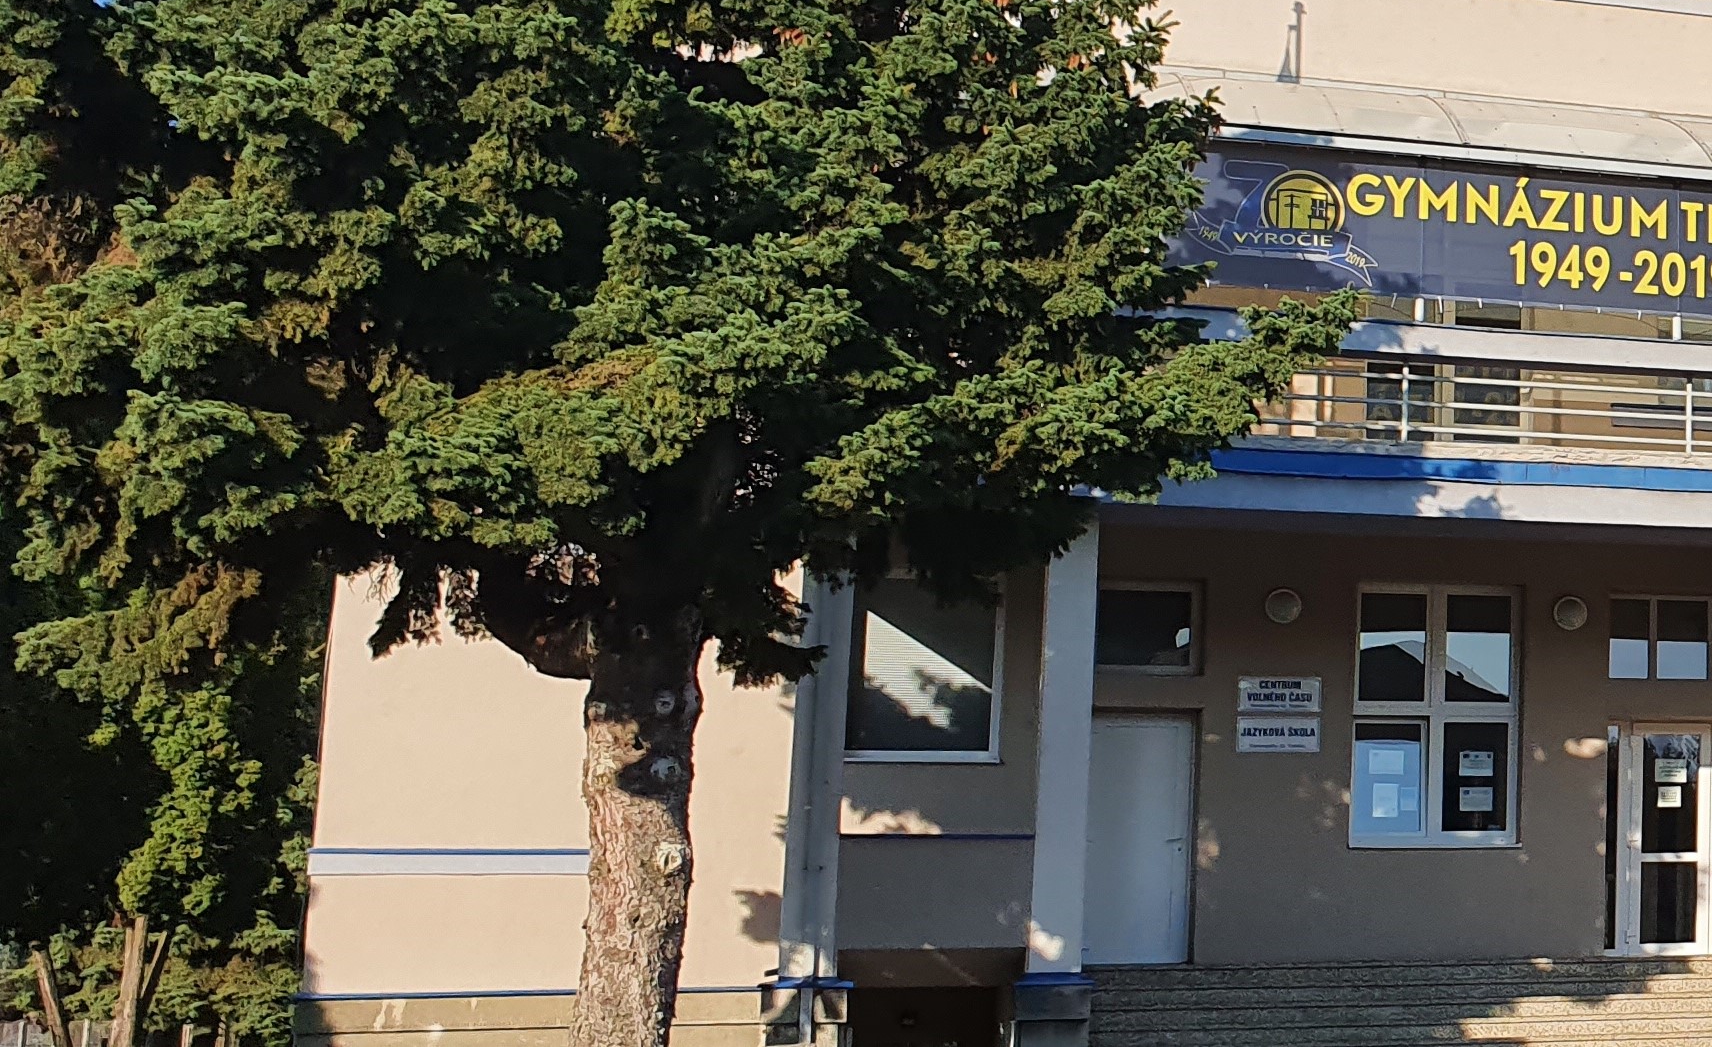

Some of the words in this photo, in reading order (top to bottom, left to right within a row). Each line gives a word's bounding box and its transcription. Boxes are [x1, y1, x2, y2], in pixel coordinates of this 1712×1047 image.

[1346, 172, 1668, 240] GYMNÁZIUM
[1198, 225, 1219, 242] 1949
[1233, 230, 1334, 248] VÝROČIE
[1346, 251, 1366, 268] 2019
[1259, 680, 1302, 690] CENTRUM
[1288, 726, 1316, 737] ŠKOLA
